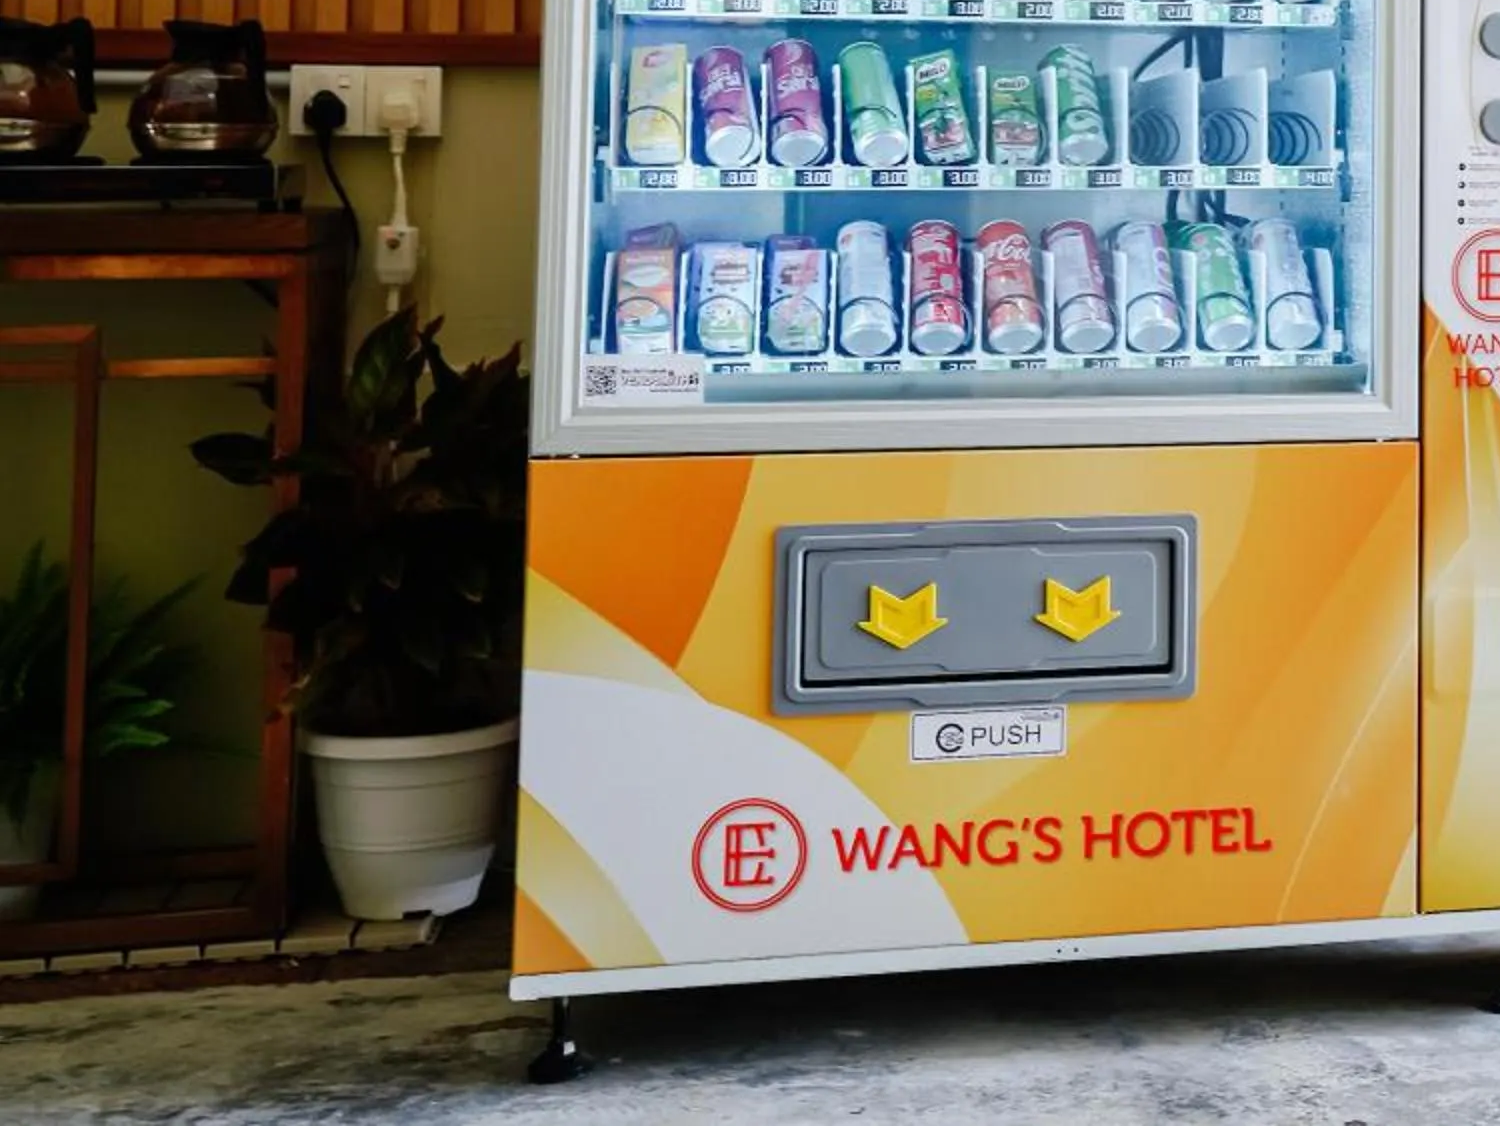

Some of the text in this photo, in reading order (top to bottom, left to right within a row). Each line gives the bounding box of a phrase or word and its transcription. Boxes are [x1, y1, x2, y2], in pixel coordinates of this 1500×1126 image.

[804, 171, 831, 185] 3.00
[952, 171, 979, 185] 3.00
[971, 724, 1041, 747] PUSH
[831, 807, 1273, 873] WANG'S HOTEL
